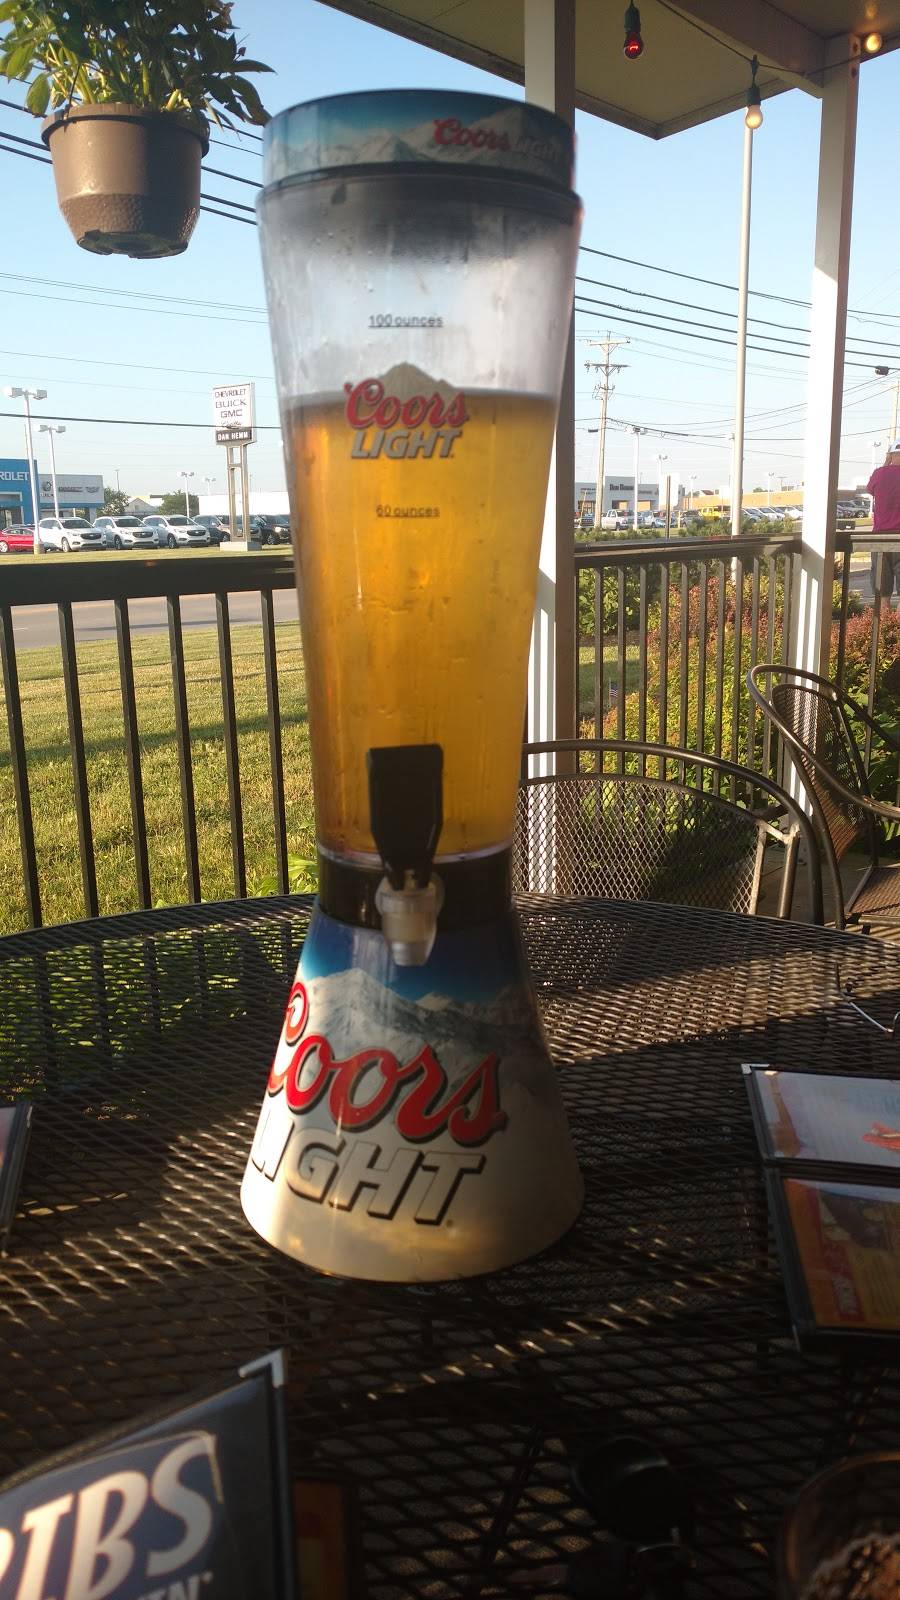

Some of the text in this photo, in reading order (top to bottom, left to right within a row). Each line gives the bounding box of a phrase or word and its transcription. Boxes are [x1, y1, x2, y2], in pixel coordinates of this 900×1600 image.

[433, 118, 512, 151] Coors
[368, 314, 444, 328] 100 ounces
[214, 388, 247, 398] CHEVROLET
[215, 399, 247, 409] BUICK
[343, 378, 469, 429] Coors
[220, 409, 243, 418] GMC
[351, 430, 463, 460] LIGHT
[376, 504, 441, 518] 60 ounces
